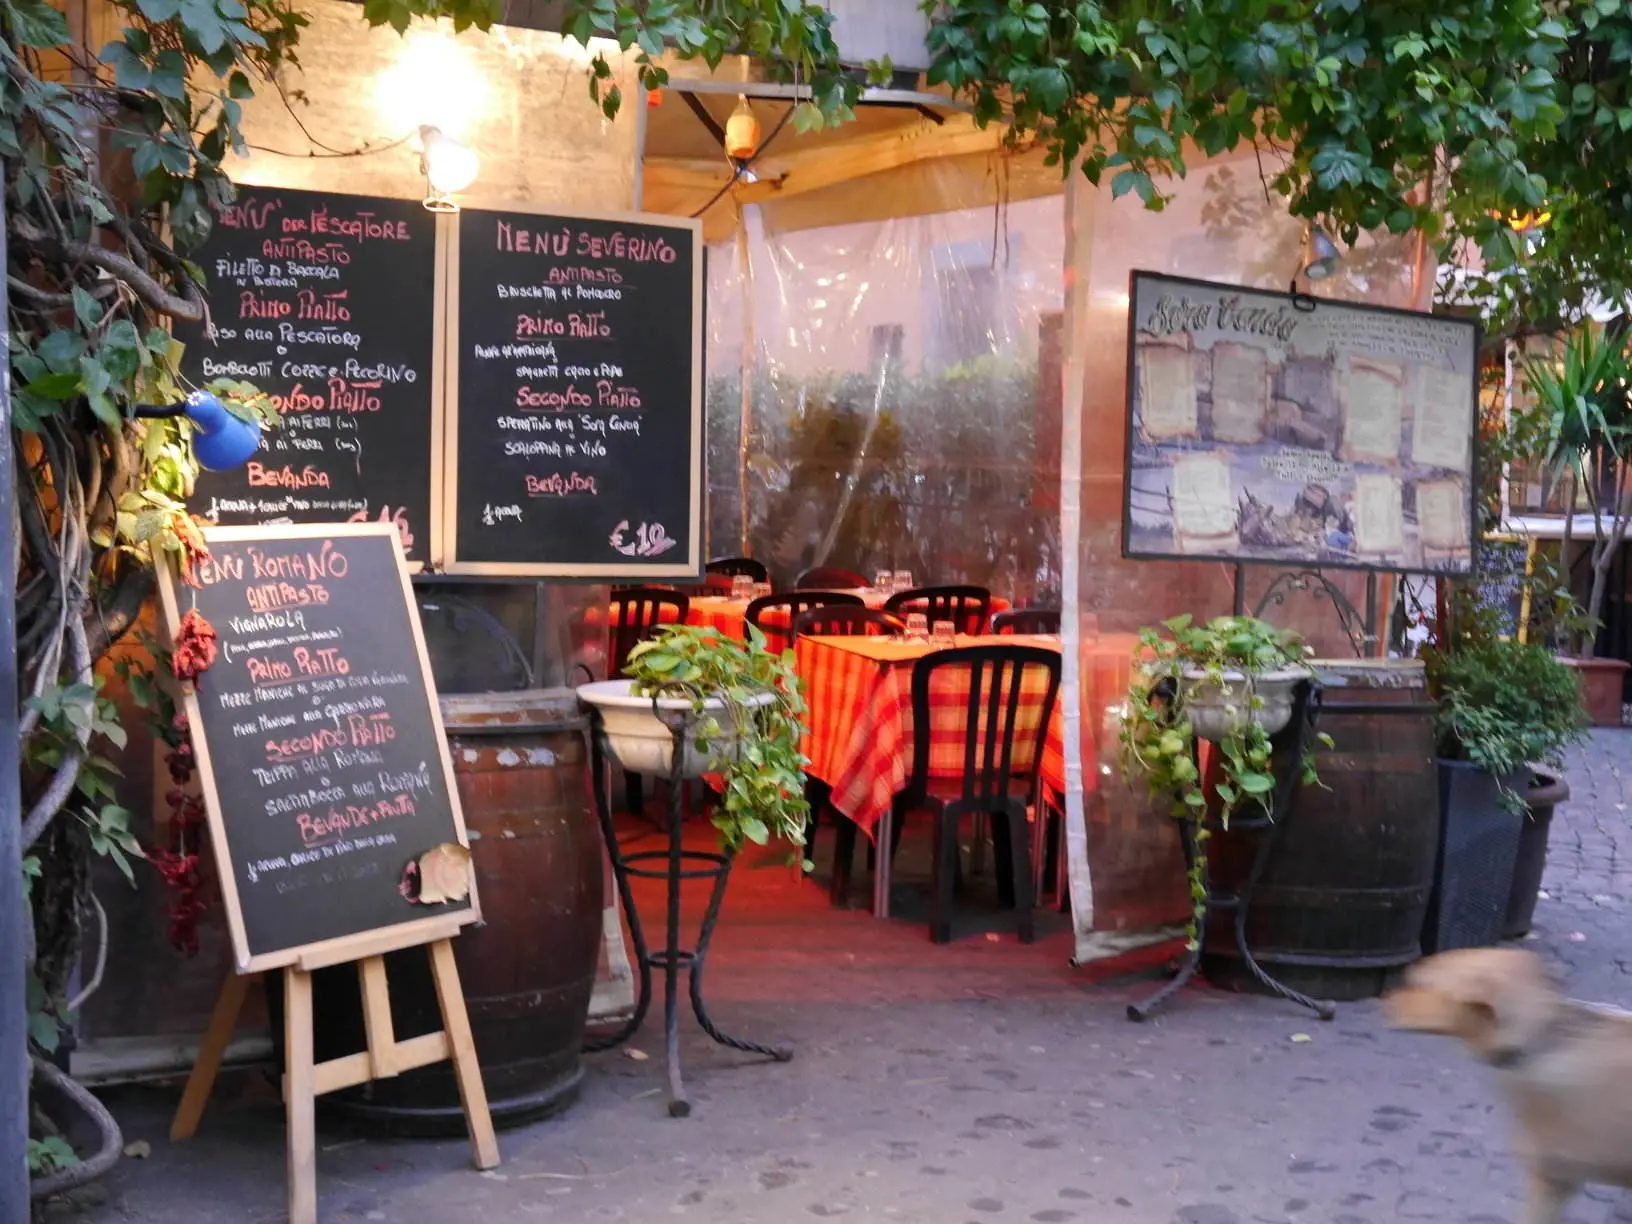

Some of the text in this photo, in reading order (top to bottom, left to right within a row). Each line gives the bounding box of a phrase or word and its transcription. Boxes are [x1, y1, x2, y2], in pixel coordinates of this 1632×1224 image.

[262, 237, 351, 264] ANTIPASTO
[576, 231, 678, 264] SEVERINO
[548, 265, 624, 285] ANTIPASTO
[239, 289, 292, 320] PRIMO
[516, 311, 565, 336] PRIMO
[516, 384, 592, 412] SECONDO
[246, 460, 331, 490] BEVANDA
[525, 471, 598, 496] BEVANDA
[247, 540, 348, 582] ROMANO
[246, 582, 330, 610] ANTIPASTO
[229, 609, 307, 636] VIGNAROLA
[246, 655, 293, 684] PRIMO
[265, 727, 348, 757] SECONDO
